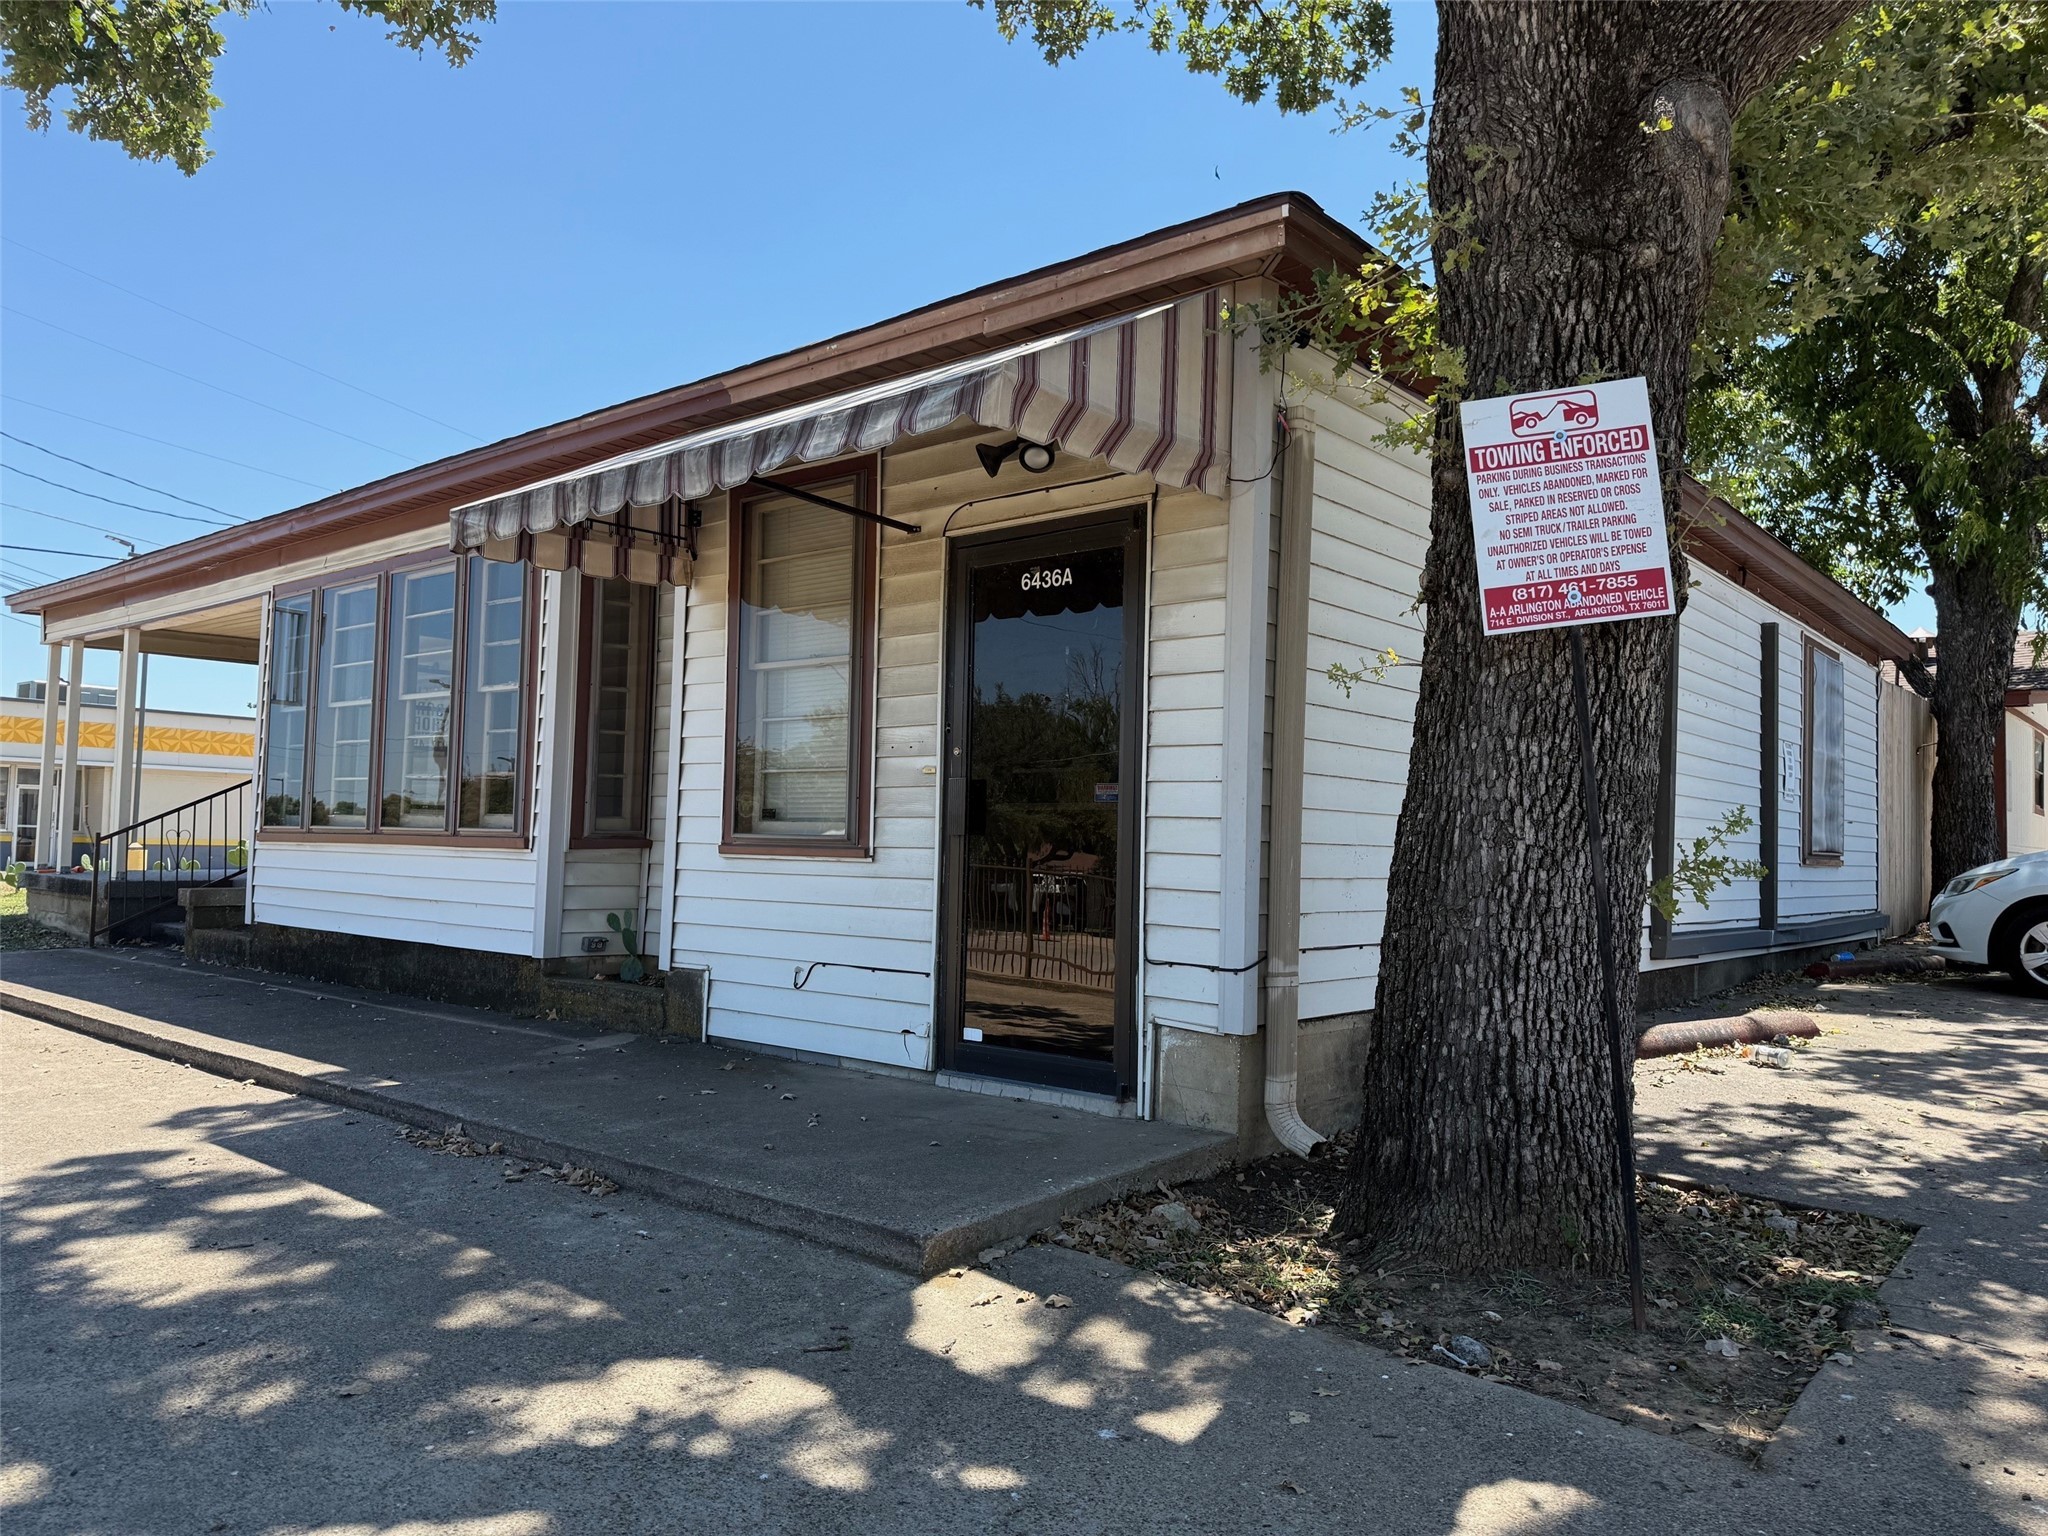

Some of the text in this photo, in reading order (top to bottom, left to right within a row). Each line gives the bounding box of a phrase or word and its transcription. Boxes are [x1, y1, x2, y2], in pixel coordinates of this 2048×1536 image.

[1475, 428, 1643, 469] TOWING ENFORCED
[1477, 453, 1646, 484] PARKING DURING BUSINESS TRANSACTIONS
[1479, 468, 1648, 499] ONLY. VEHICLES ABANDONED, MARKED FOR
[1489, 483, 1641, 512] SALE, PARKED IN RESERVED OR CROSS
[1500, 530, 1510, 540] NO
[1513, 527, 1532, 538] SEMI
[1602, 513, 1636, 527] PARKING
[1506, 500, 1627, 525] STRIPED AREAS NOT ALLOWED.
[1488, 526, 1652, 557] UNAUTHORIZED VEHICLES WILL BE TOWED
[1497, 542, 1647, 570] AT OWNER'S OR OPERATOR'S EXPENSE
[1021, 568, 1072, 590] 6436A
[1526, 560, 1620, 581] AT ALL TIMES AND DAYS
[1512, 575, 1638, 601] (817) 461-7855
[1490, 606, 1506, 618] A-A
[1508, 599, 1562, 616] ARLINGTON
[1624, 587, 1665, 602] VEHICLE
[1490, 619, 1504, 627] 714
[1517, 613, 1554, 624] DIVISION
[1575, 605, 1627, 617] ARLINGTON,
[1629, 603, 1640, 611] TX
[1642, 600, 1666, 609] 76011
